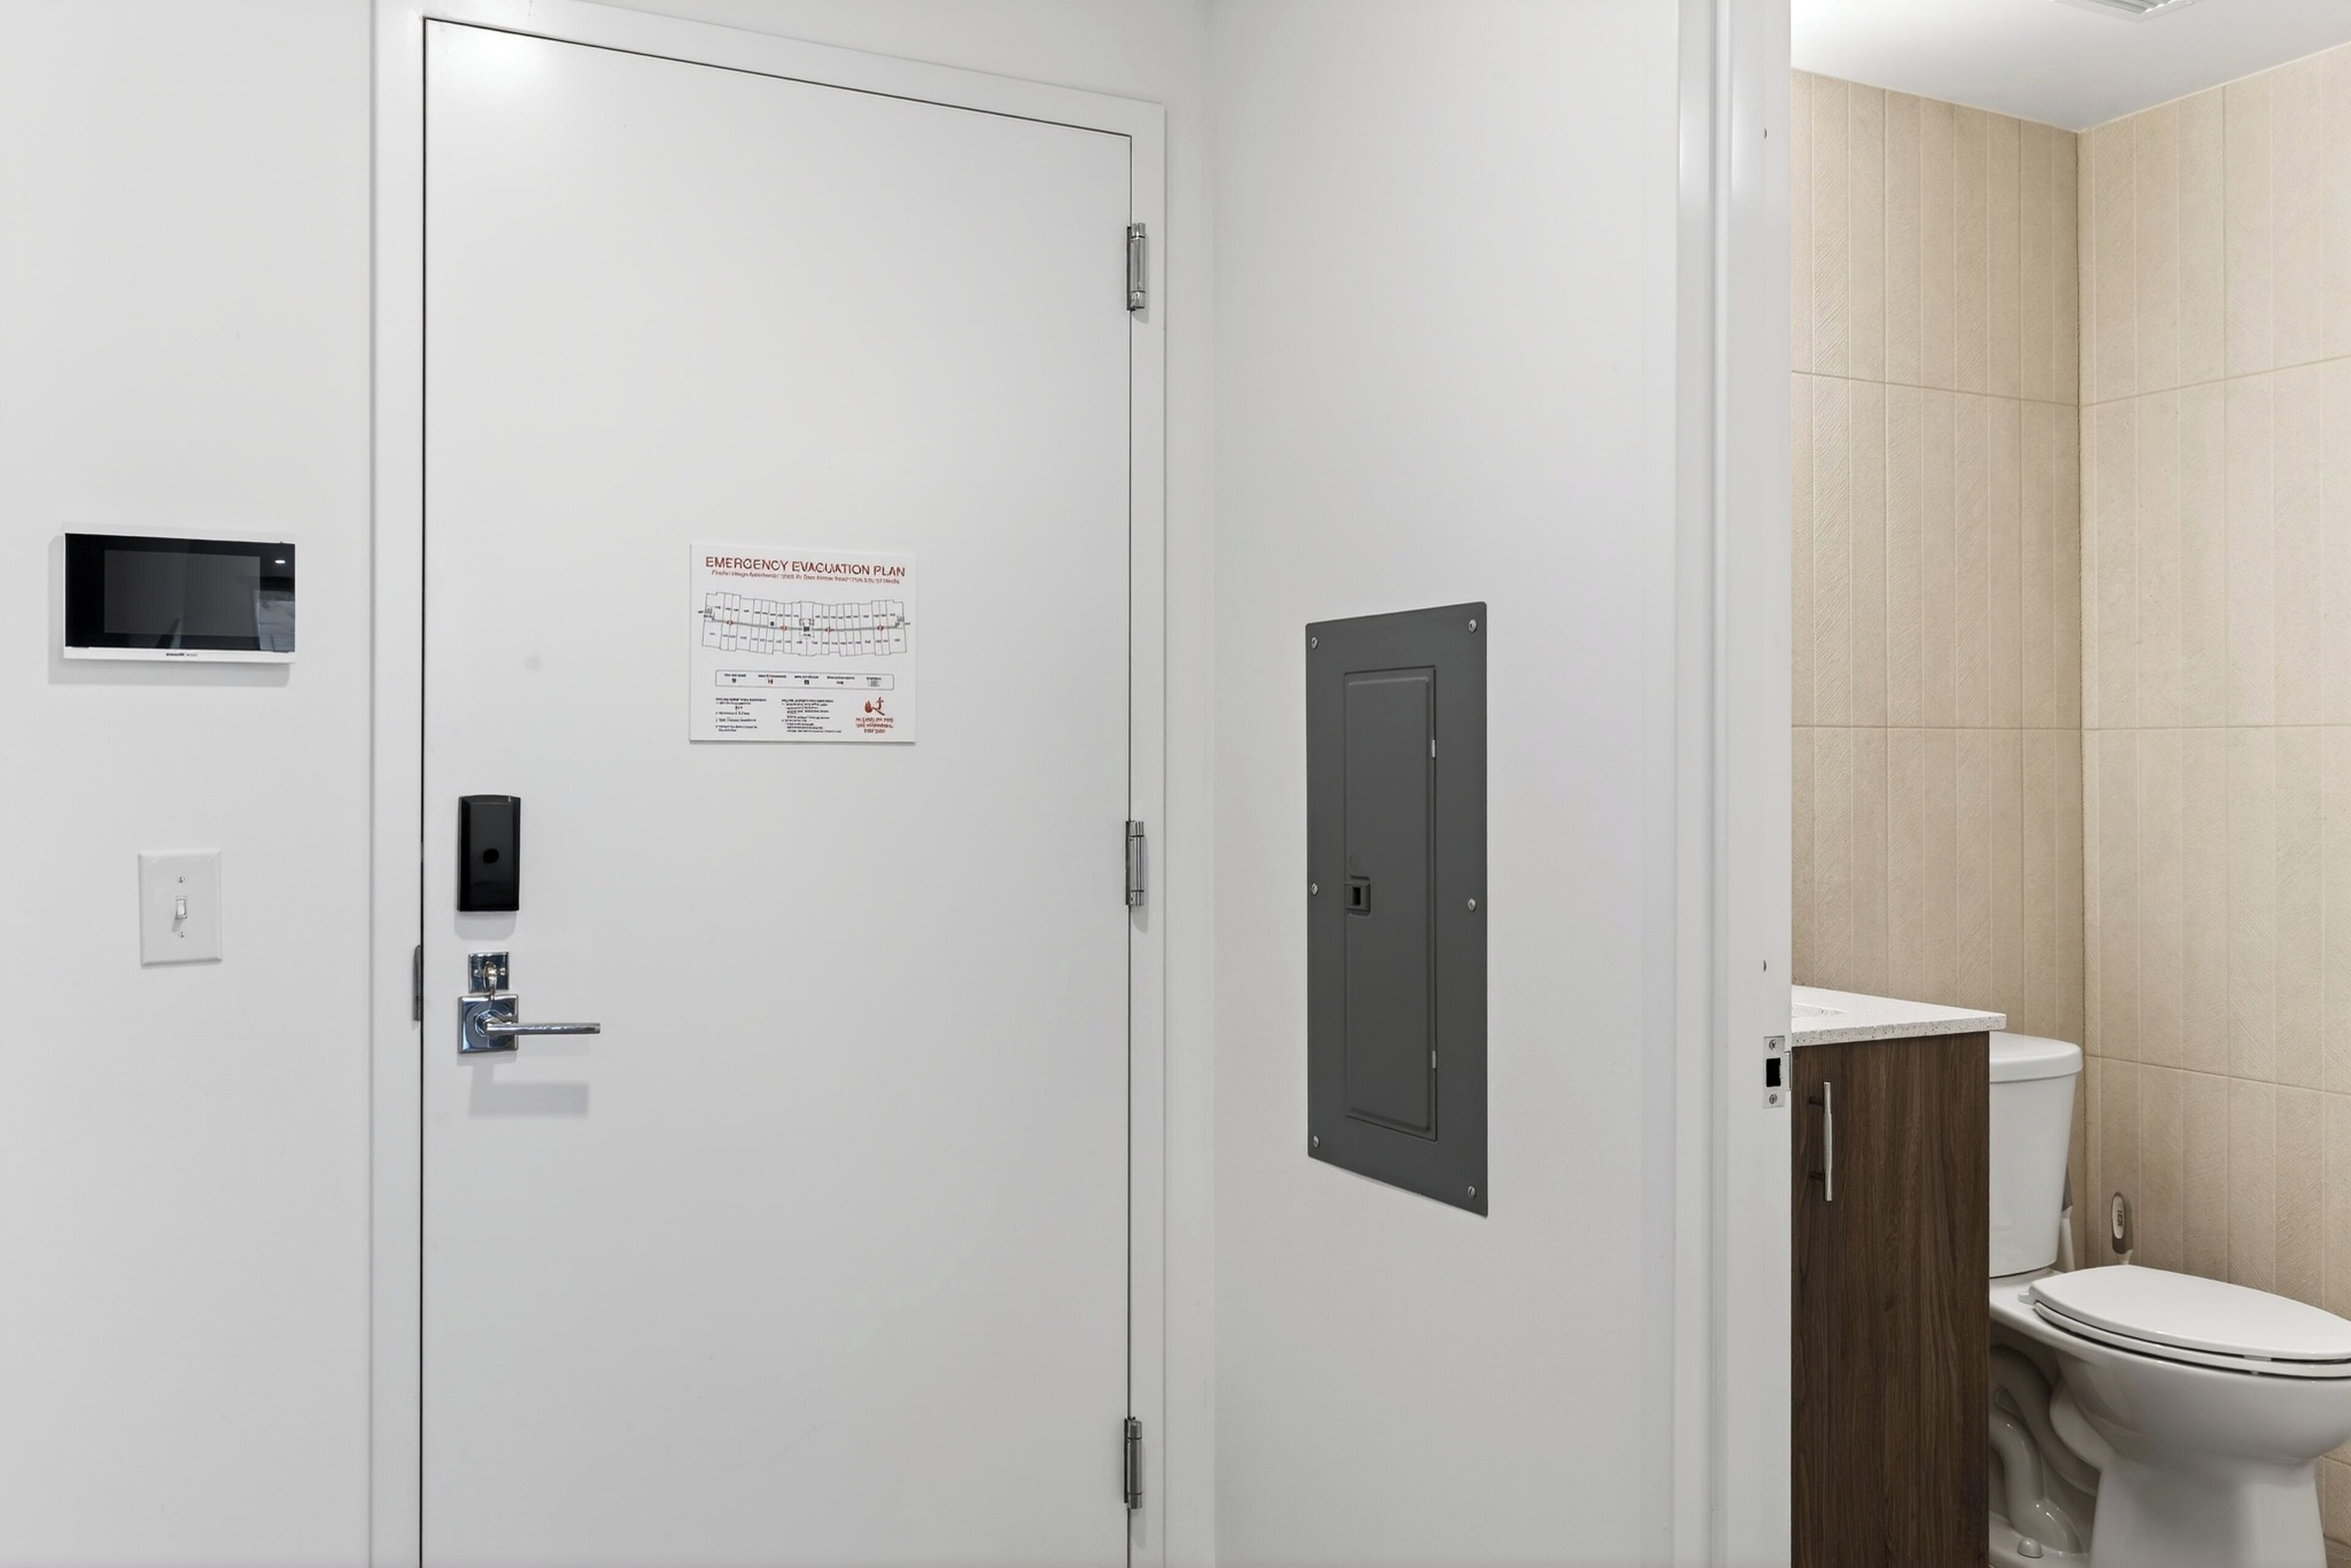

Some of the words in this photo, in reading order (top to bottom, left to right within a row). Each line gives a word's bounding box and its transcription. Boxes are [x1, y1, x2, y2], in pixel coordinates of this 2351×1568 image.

[705, 556, 789, 571] EMERGENCY
[792, 560, 870, 576] EVACUATION
[874, 565, 906, 577] PLAN
